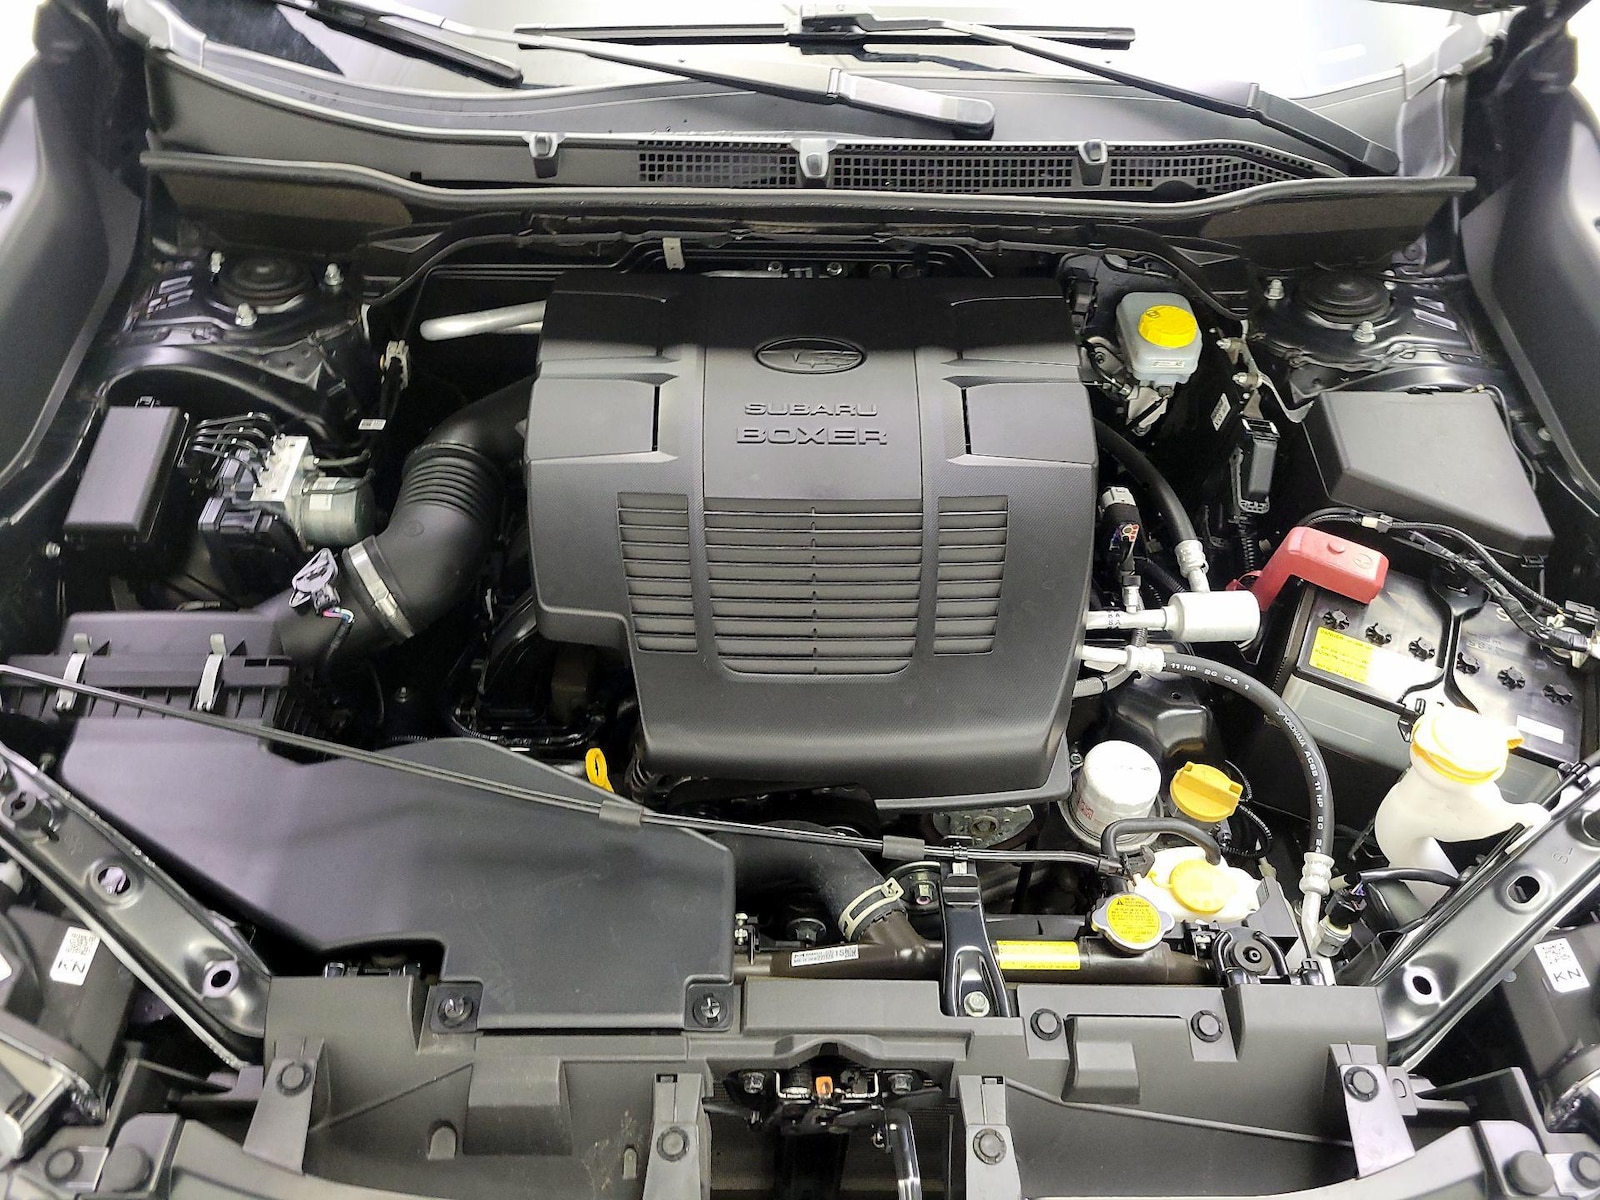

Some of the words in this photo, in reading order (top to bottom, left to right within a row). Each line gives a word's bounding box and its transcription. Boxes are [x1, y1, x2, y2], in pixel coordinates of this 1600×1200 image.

[744, 402, 878, 417] SUBARU
[736, 427, 888, 446] BOXER
[1183, 664, 1197, 672] HP
[1316, 794, 1324, 808] HP
[1552, 967, 1582, 983] KN
